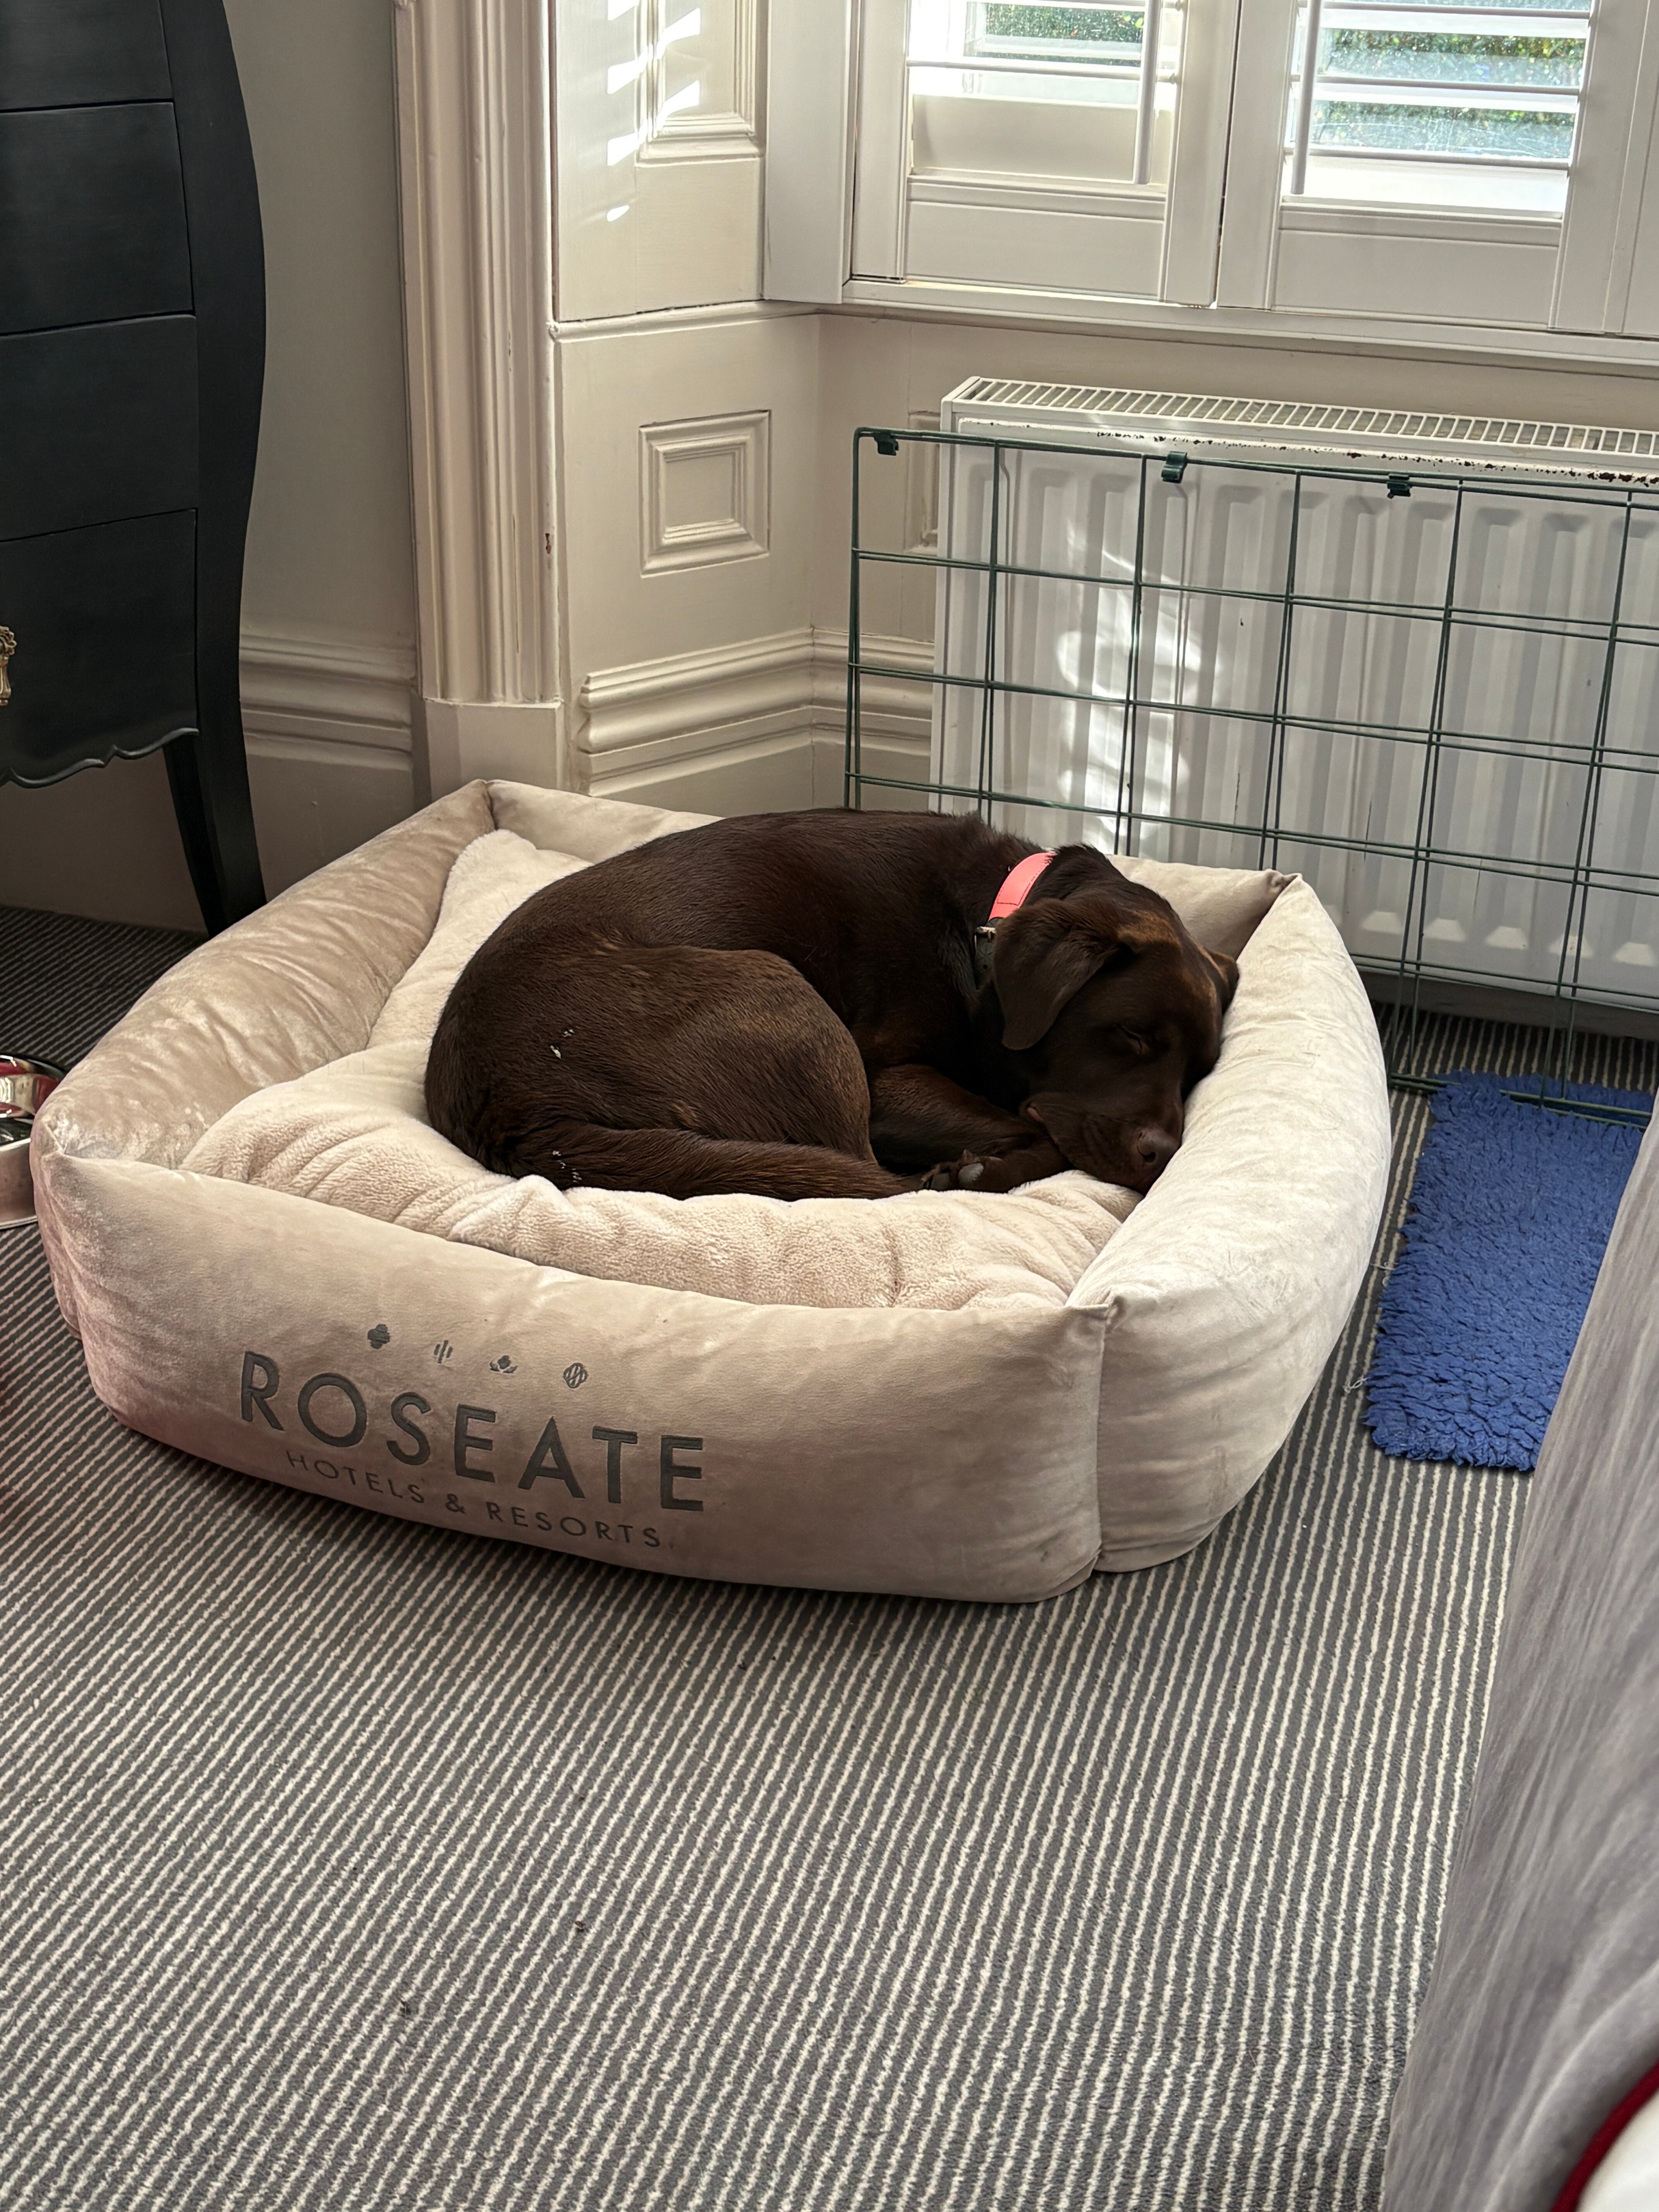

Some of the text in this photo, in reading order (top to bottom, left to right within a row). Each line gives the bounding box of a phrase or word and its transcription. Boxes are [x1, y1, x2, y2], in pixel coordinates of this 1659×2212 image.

[240, 1351, 704, 1511] ROSEATE
[286, 1450, 661, 1547] HOTELS & RESORTS
